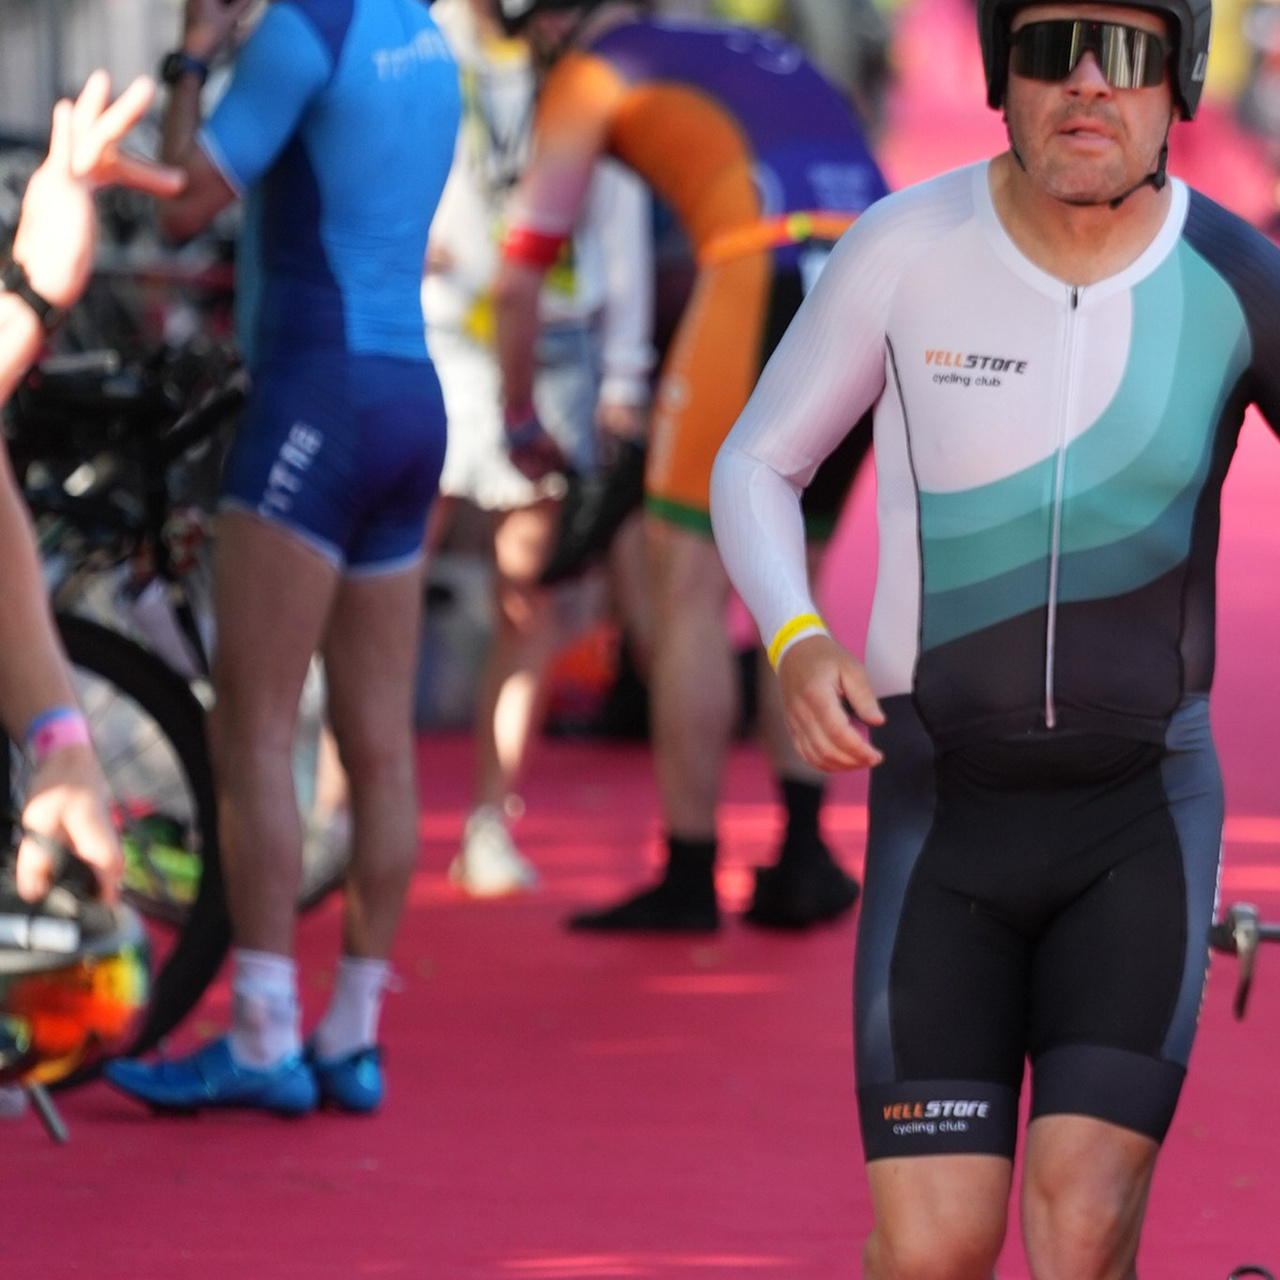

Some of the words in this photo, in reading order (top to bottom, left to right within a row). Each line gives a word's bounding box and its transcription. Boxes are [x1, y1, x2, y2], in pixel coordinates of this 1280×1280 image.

[932, 373, 971, 387] cycling
[974, 376, 1001, 387] club
[892, 1121, 937, 1135] cycling
[939, 1120, 969, 1132] club
